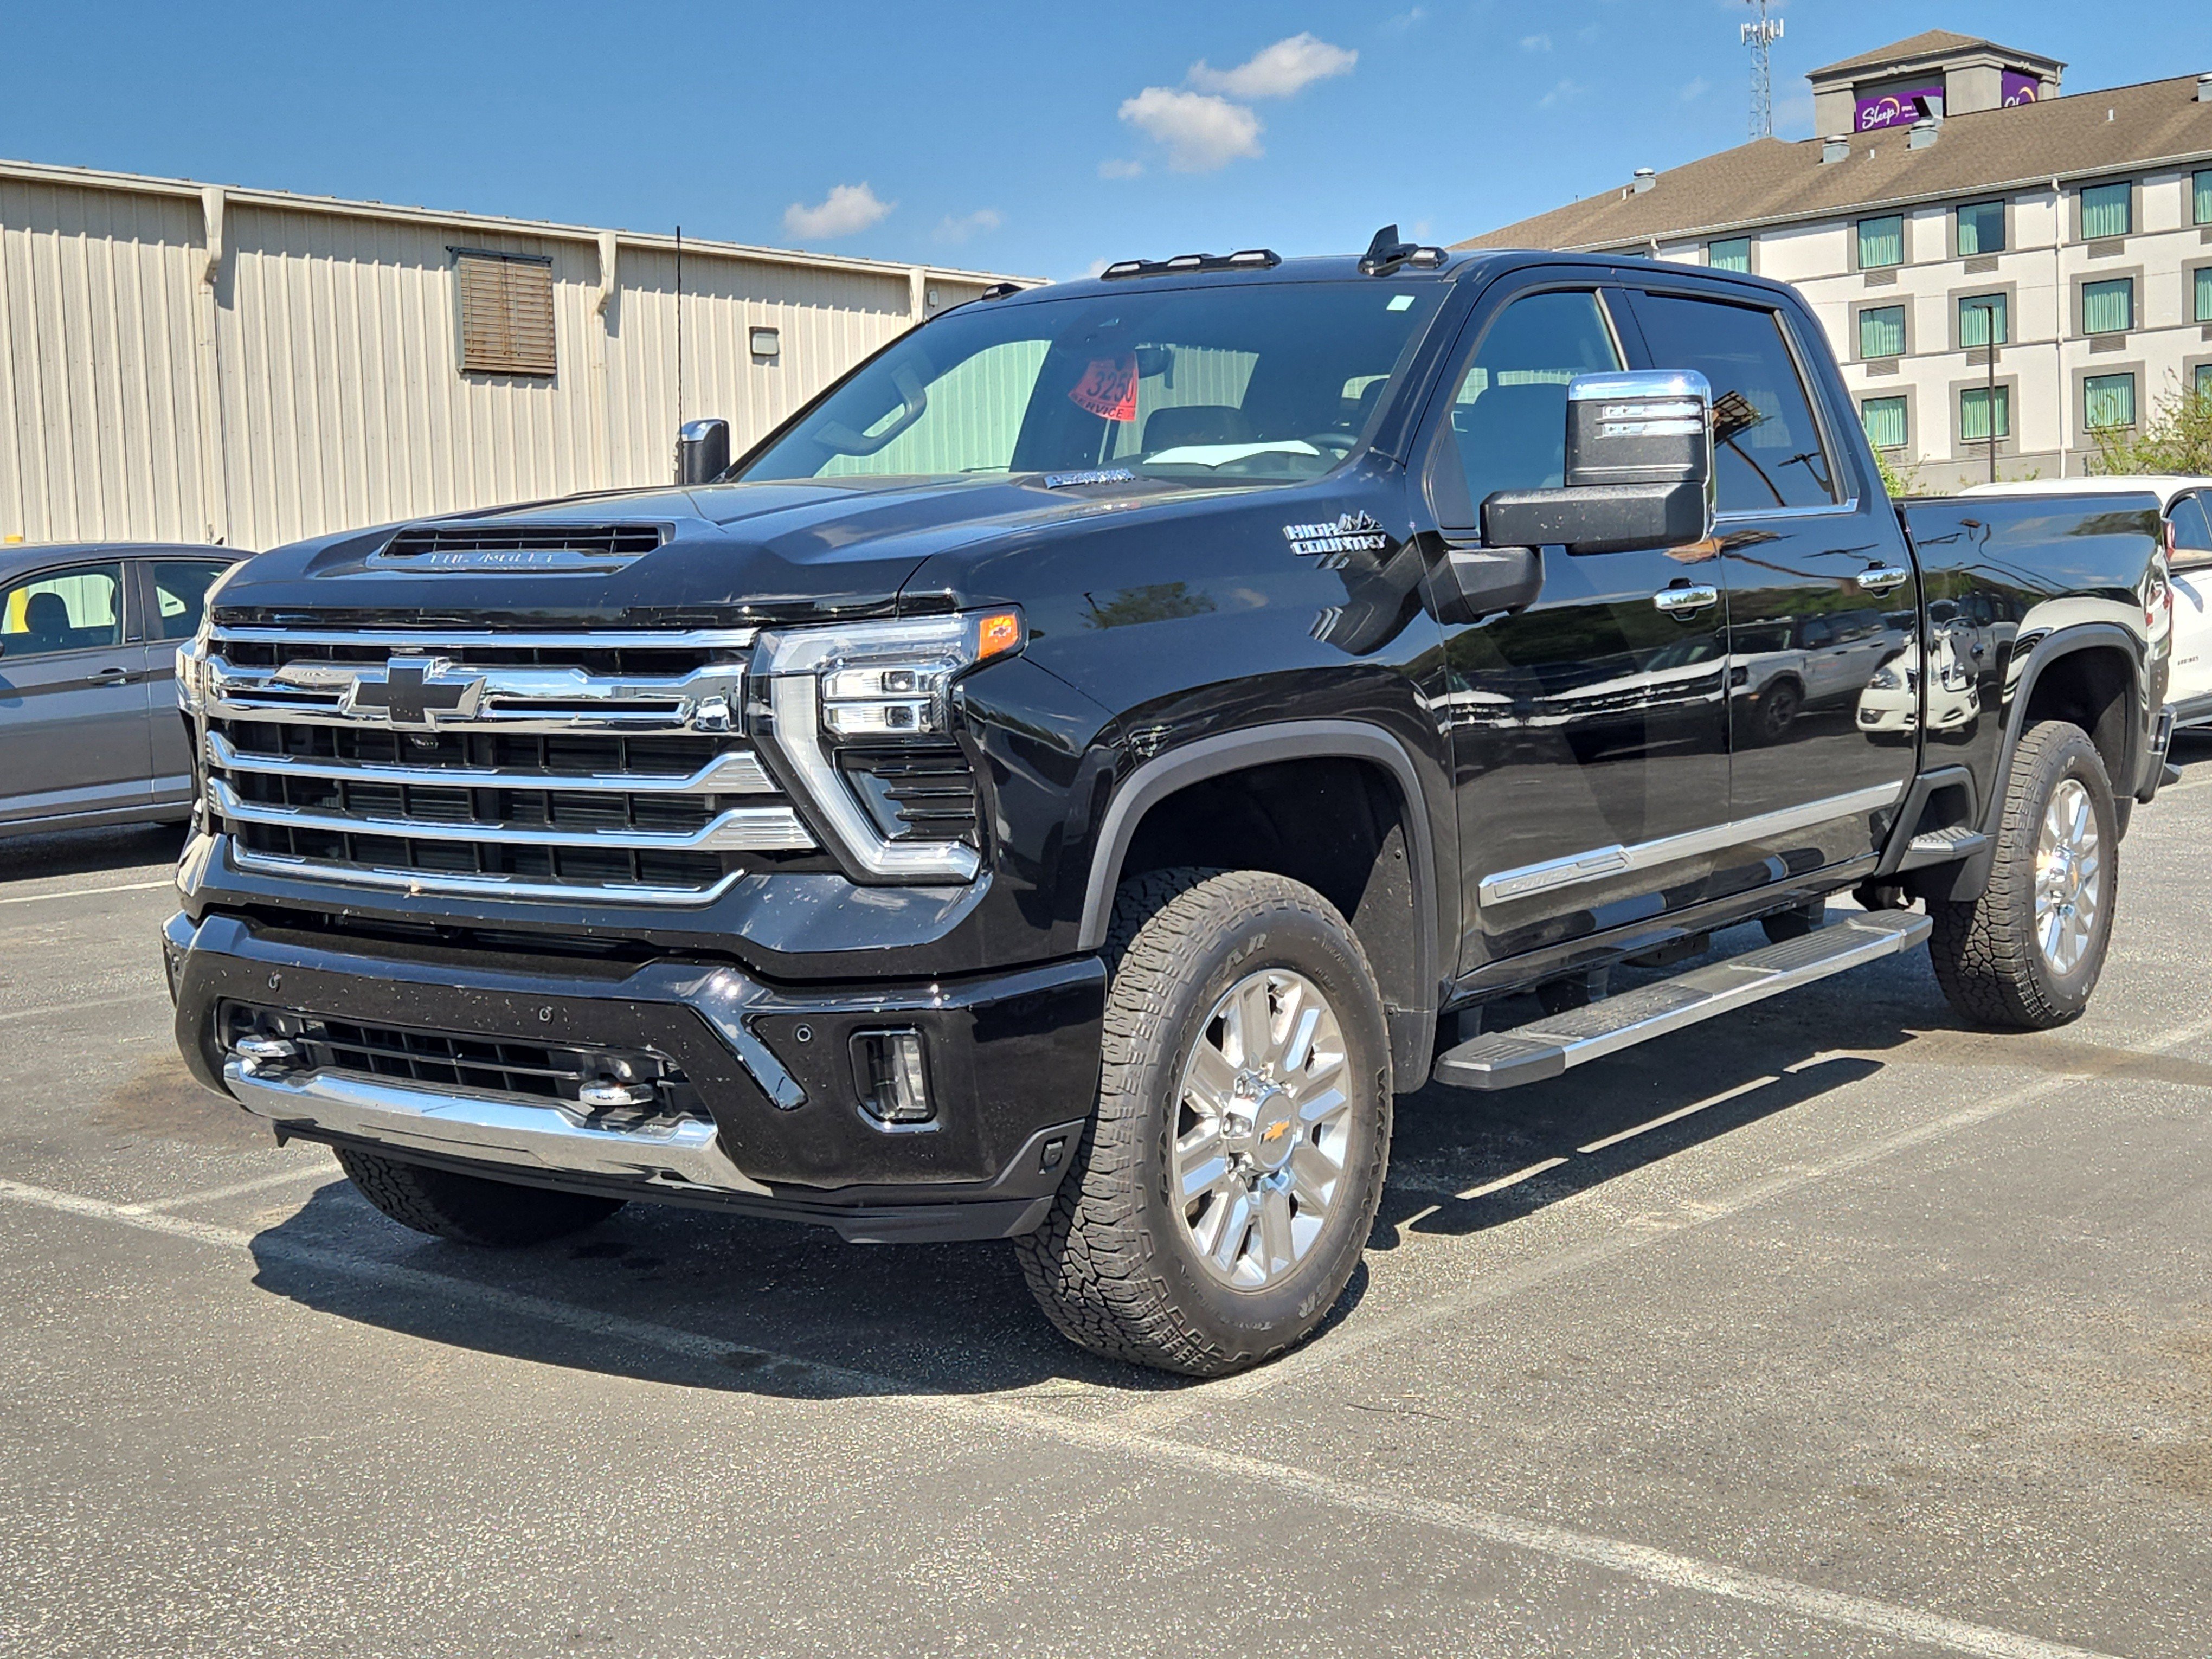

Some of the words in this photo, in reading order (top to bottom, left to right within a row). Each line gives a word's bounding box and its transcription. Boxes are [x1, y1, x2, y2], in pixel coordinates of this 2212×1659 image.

[1862, 105, 1896, 129] Sleep
[1283, 522, 1342, 541] HIGH
[1290, 534, 1386, 556] COUNTRY
